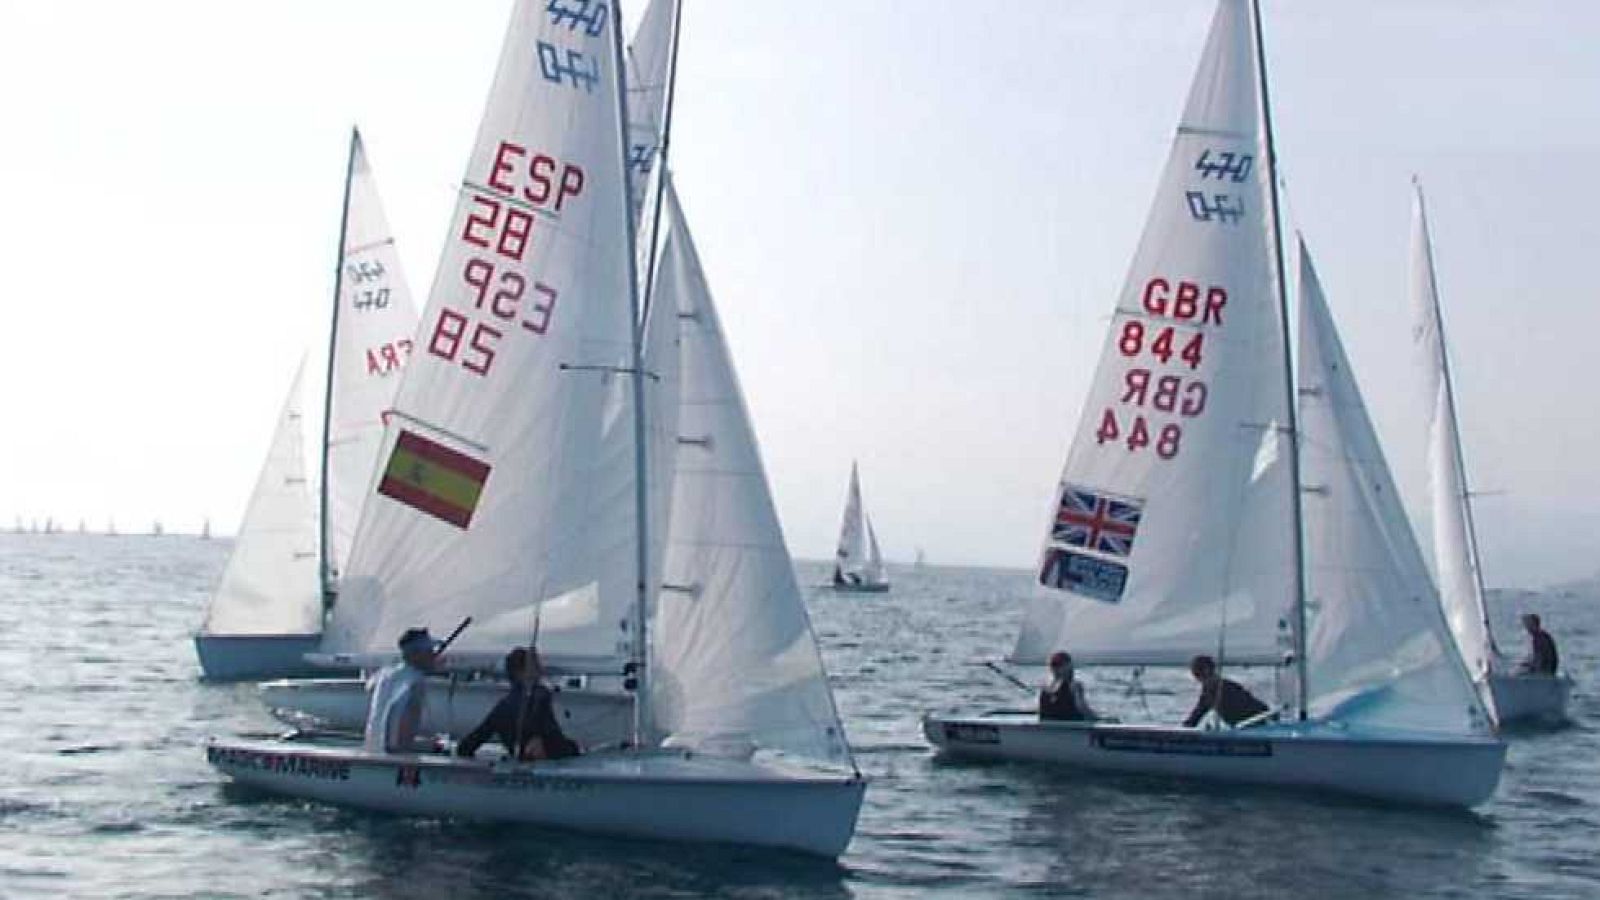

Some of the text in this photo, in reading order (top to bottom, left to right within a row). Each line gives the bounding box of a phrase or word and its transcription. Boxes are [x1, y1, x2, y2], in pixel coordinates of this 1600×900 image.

[546, 0, 607, 37] 470
[488, 139, 583, 211] ESP
[1196, 148, 1253, 183] 470
[462, 195, 533, 260] 28
[1143, 278, 1227, 326] GBR
[1120, 321, 1203, 369] 844
